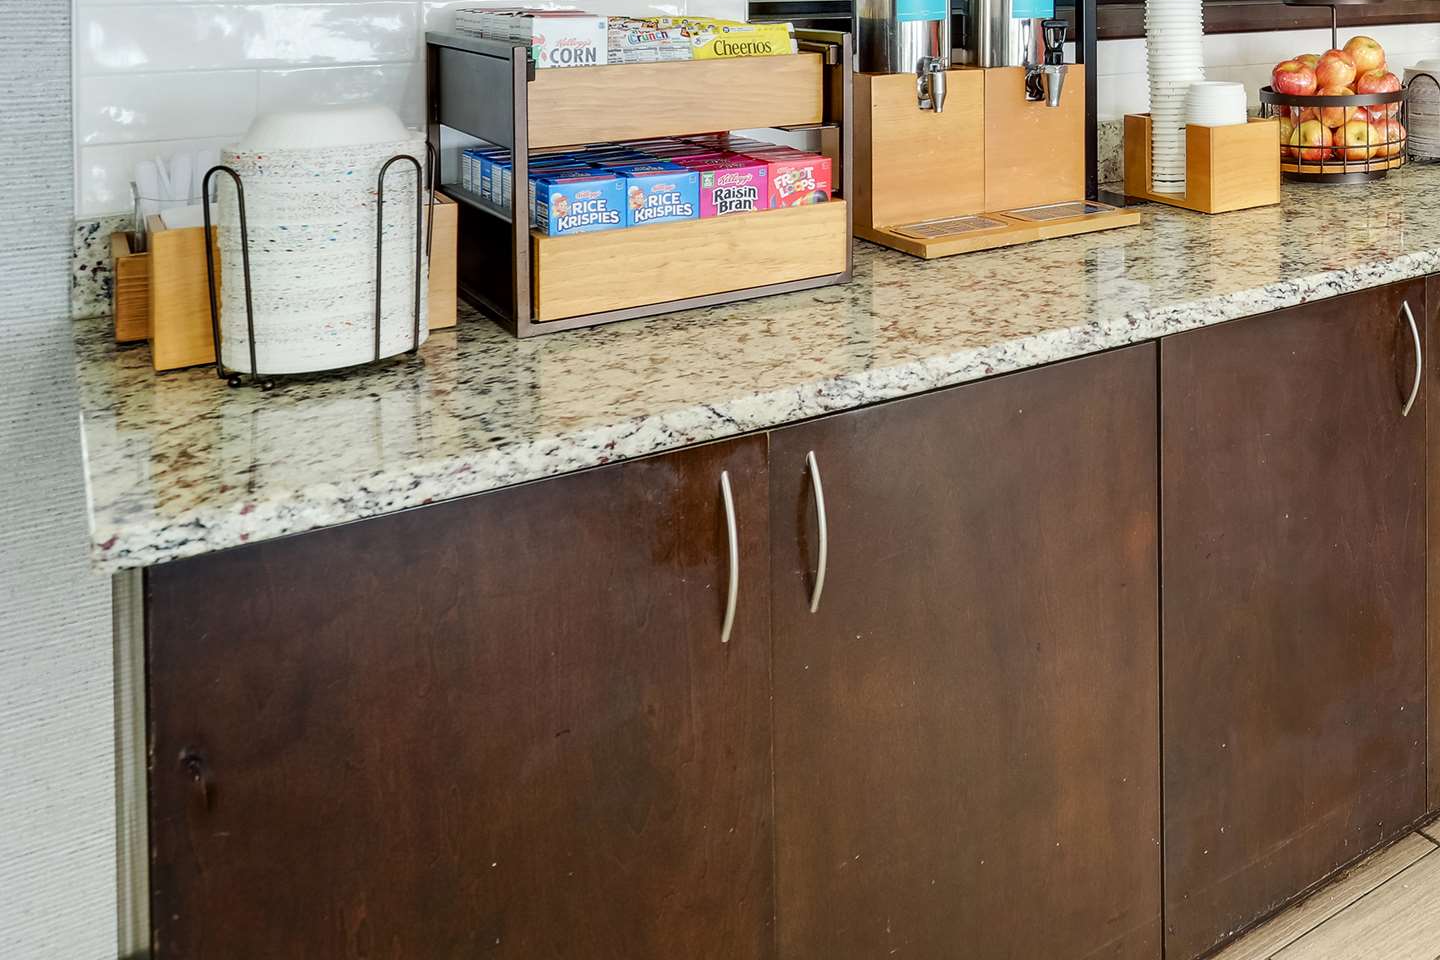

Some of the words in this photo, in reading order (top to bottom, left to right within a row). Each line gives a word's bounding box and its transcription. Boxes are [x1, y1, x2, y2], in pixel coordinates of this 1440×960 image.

[550, 47, 597, 64] CORN
[713, 39, 772, 56] Cheerios
[718, 172, 753, 186] Kellogg's
[773, 167, 814, 190] FROOT
[713, 186, 757, 204] Raisin
[779, 178, 816, 198] LOOPS
[572, 199, 608, 215] RICE
[648, 192, 681, 207] RICE
[718, 198, 753, 214] Bran
[557, 210, 620, 232] KRISPIES
[634, 203, 693, 223] KRISPIES
